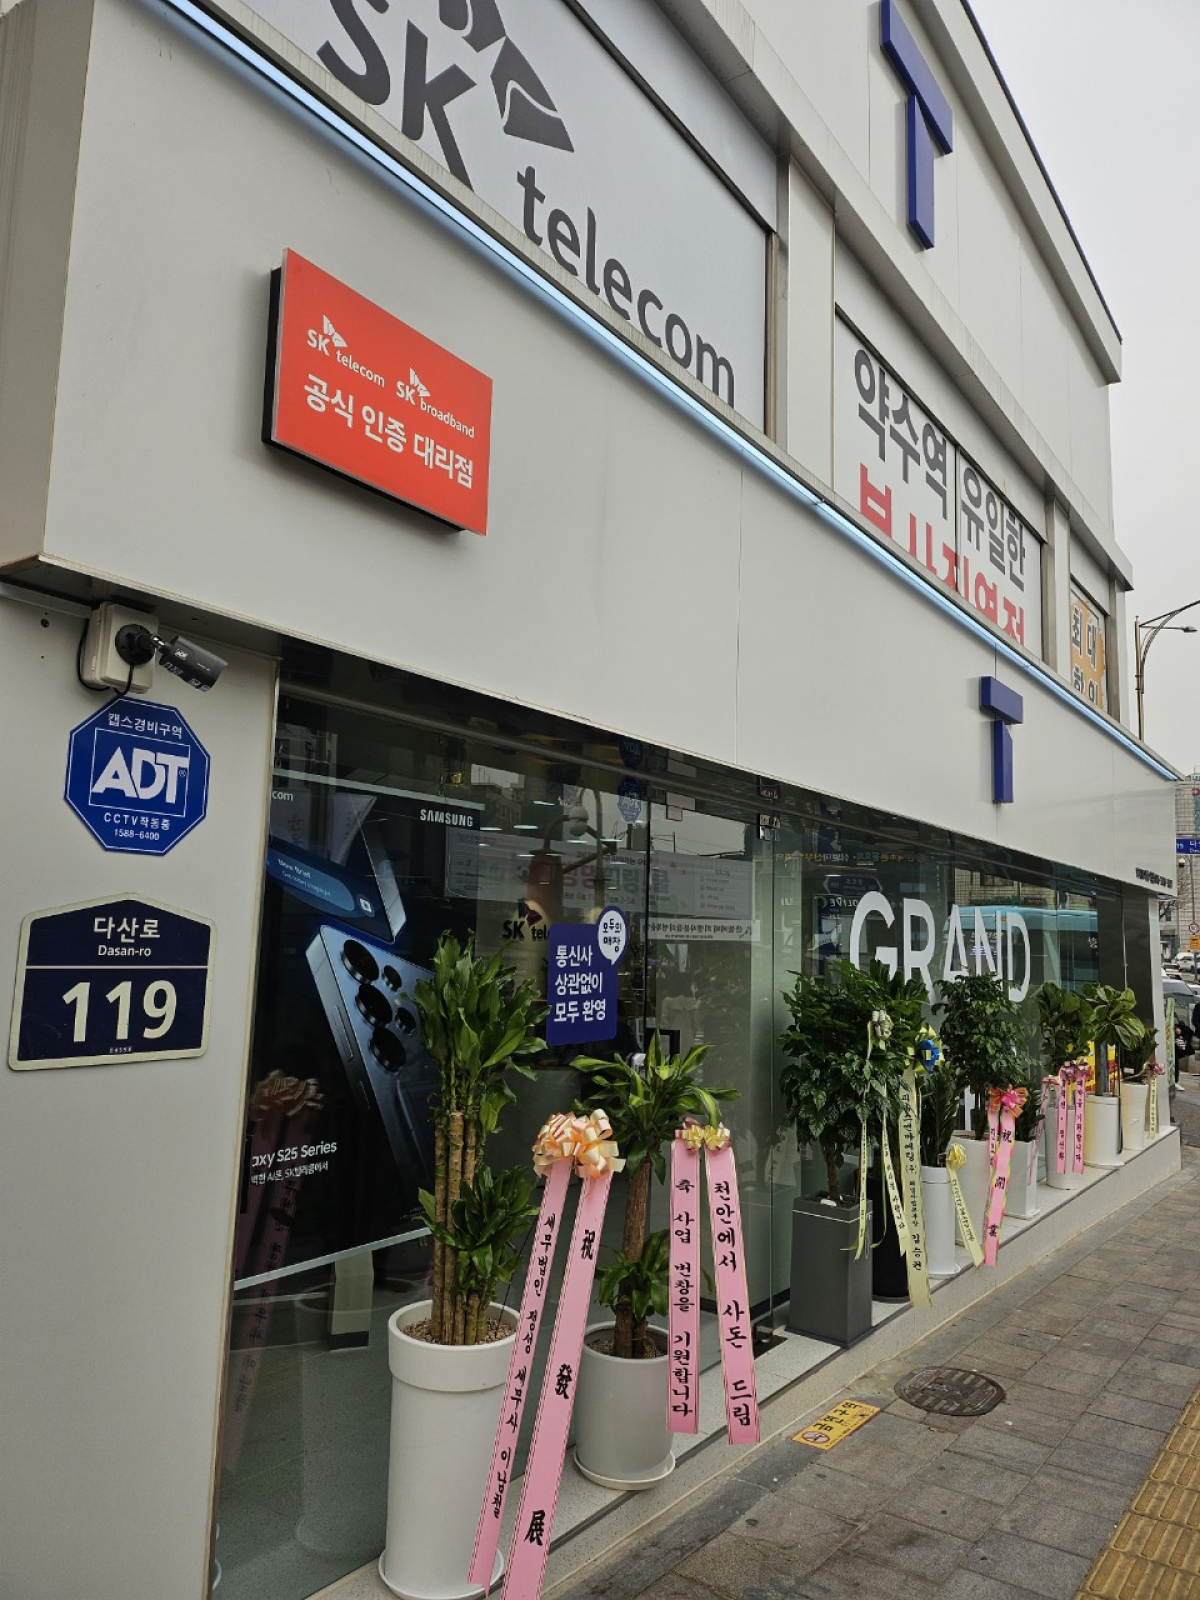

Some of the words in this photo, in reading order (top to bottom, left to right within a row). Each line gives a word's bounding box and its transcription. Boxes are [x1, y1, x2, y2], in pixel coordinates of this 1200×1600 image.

[316, 0, 477, 192] SK
[517, 166, 735, 408] telecom
[307, 329, 330, 356] SK
[336, 350, 385, 388] telecom
[304, 373, 353, 428] 공식
[362, 405, 407, 453] 인증
[413, 433, 473, 489] 대리점
[396, 380, 415, 405] SK
[420, 397, 475, 438] broadband
[854, 349, 947, 521] 약수역
[961, 467, 1026, 592] 유일한
[1072, 605, 1097, 670] 최대
[108, 712, 183, 739] 캡스경비구역
[91, 746, 190, 804] ADT
[271, 789, 294, 802] com
[114, 828, 160, 841] 1588-6400
[420, 808, 474, 828] SAMSUNG
[93, 916, 161, 943] 다산로
[502, 919, 525, 941] SK
[531, 924, 550, 942] tel
[602, 918, 622, 934] 모두의
[603, 936, 621, 953] 매장
[850, 890, 1031, 1004] GRAND
[98, 944, 152, 957] Dasan-ro
[555, 944, 593, 968] 통신사
[554, 972, 603, 996] 상관없이
[62, 979, 178, 1043] 119
[553, 1001, 579, 1023] 모두
[582, 999, 606, 1021] 환영
[277, 1146, 298, 1163] S25
[301, 1140, 338, 1158] Series
[675, 1178, 695, 1194] 축
[674, 1210, 695, 1244] 사업
[714, 1180, 737, 1272] 천안에서
[534, 1213, 556, 1297] 세무법인
[673, 1262, 695, 1312] 번창을
[522, 1309, 539, 1354] 정성
[722, 1300, 747, 1349] 사돈
[672, 1332, 693, 1417] 기원합니다
[505, 1366, 527, 1434] 세무사
[730, 1379, 753, 1426] 드림
